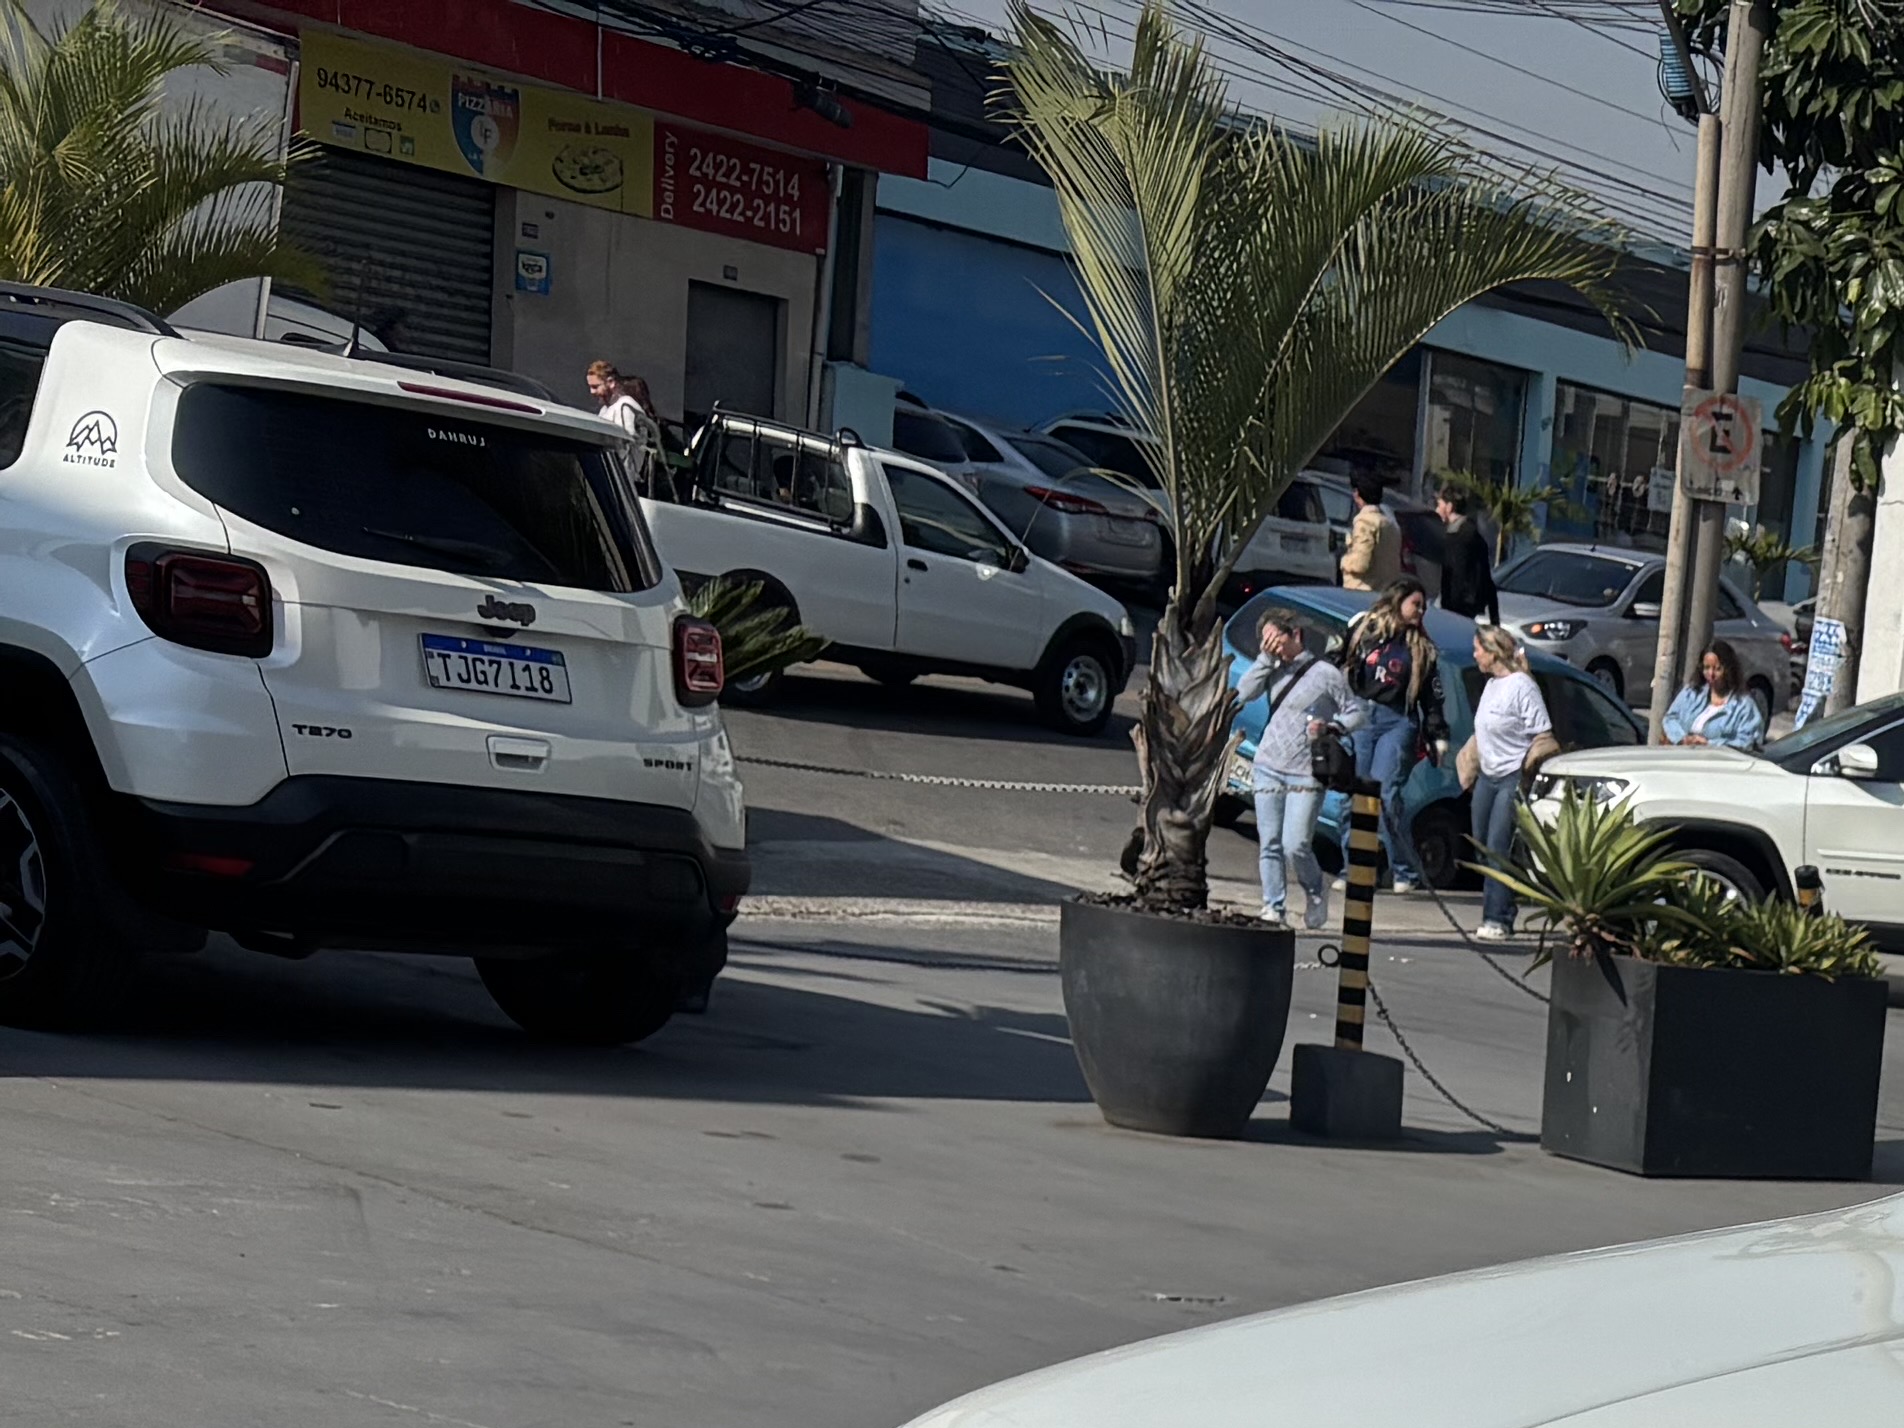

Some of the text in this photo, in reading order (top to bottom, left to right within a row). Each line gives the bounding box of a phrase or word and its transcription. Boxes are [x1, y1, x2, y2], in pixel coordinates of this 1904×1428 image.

[317, 67, 428, 113] 94377-6574
[344, 107, 402, 131] Aceitamos
[660, 131, 678, 220] Delivery
[688, 147, 800, 201] 2422-7514
[692, 184, 801, 236] 2422-2151
[62, 453, 116, 468] ALTITUDE
[477, 594, 536, 627] Jeep
[436, 652, 554, 695] TJG7118
[291, 723, 352, 739] T270
[643, 757, 693, 772] SPORT
